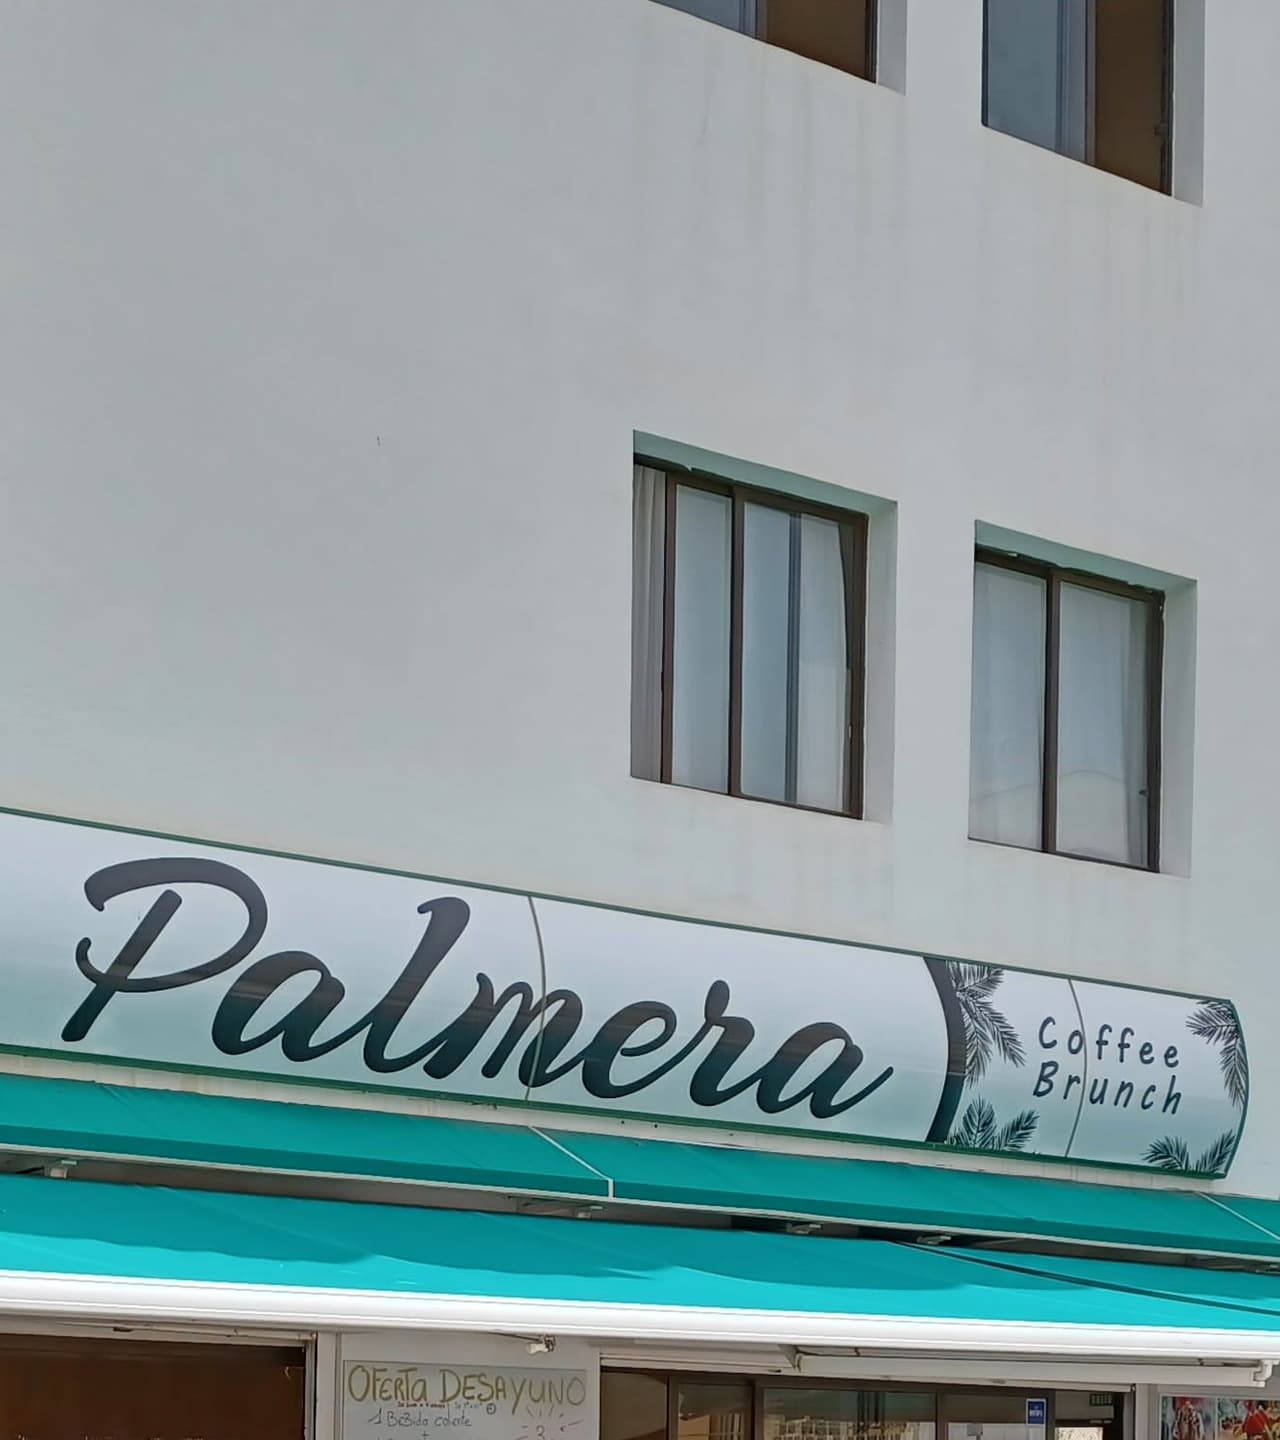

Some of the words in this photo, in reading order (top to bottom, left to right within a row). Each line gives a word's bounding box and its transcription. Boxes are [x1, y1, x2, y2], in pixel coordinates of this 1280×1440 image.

[61, 856, 894, 1119] Palmera
[1037, 1016, 1180, 1069] Coffee
[1032, 1060, 1182, 1115] Brunch
[368, 1407, 382, 1425] 1
[439, 1369, 586, 1415] DESAYUNO
